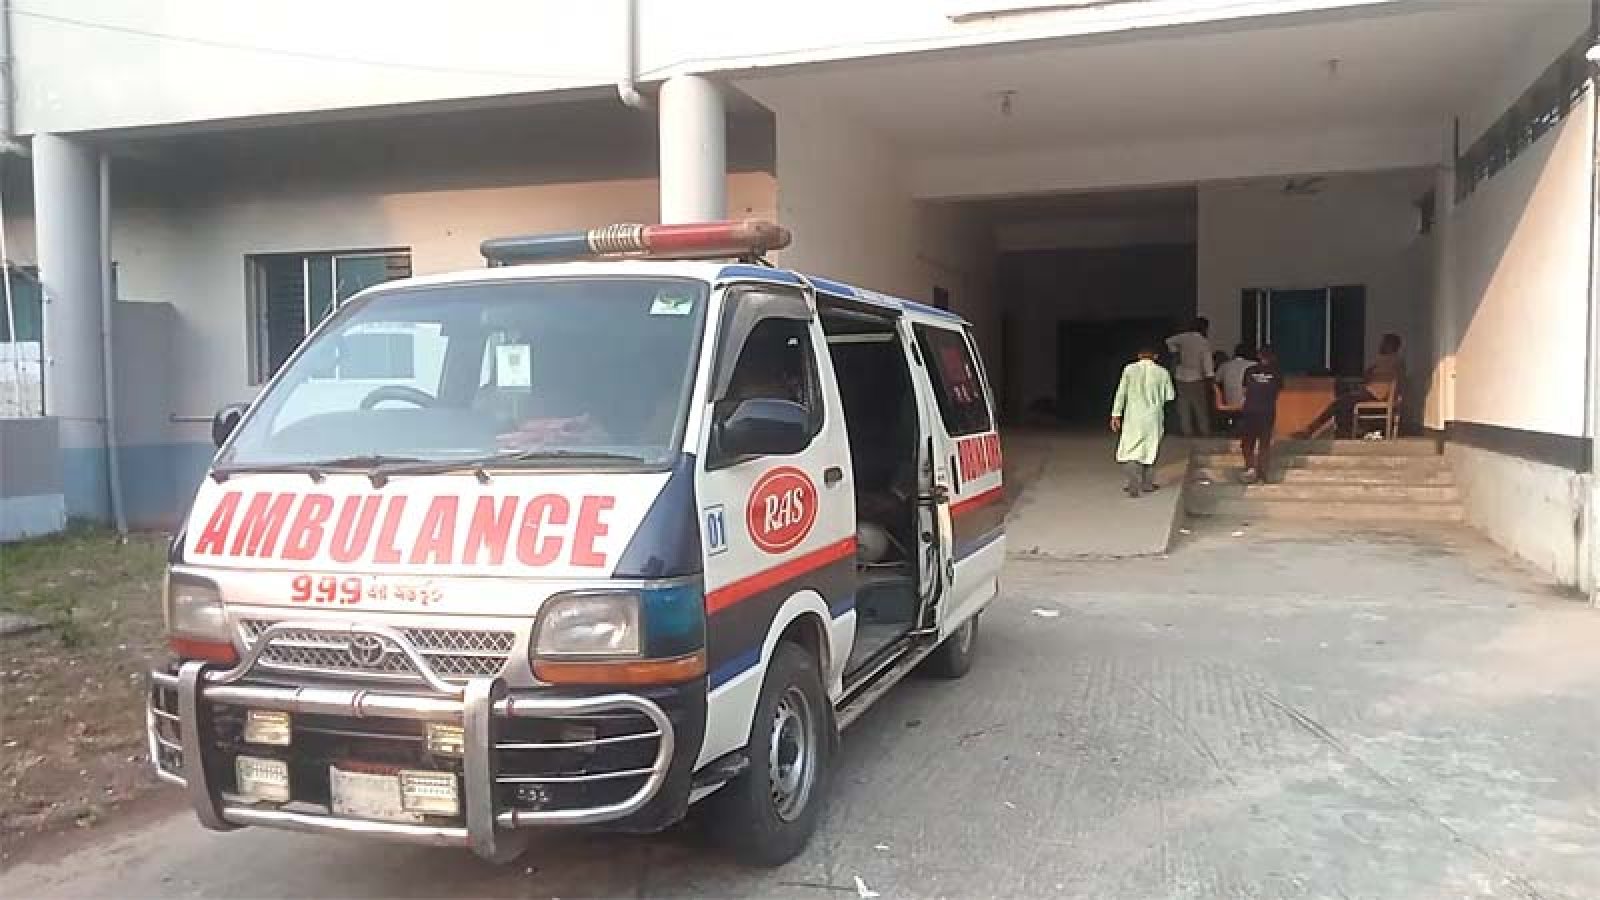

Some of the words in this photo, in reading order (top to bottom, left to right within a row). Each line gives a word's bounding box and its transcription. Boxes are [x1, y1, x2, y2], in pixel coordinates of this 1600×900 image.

[194, 491, 616, 568] AMBULANCE
[707, 511, 725, 549] 01
[764, 487, 804, 534] RAS
